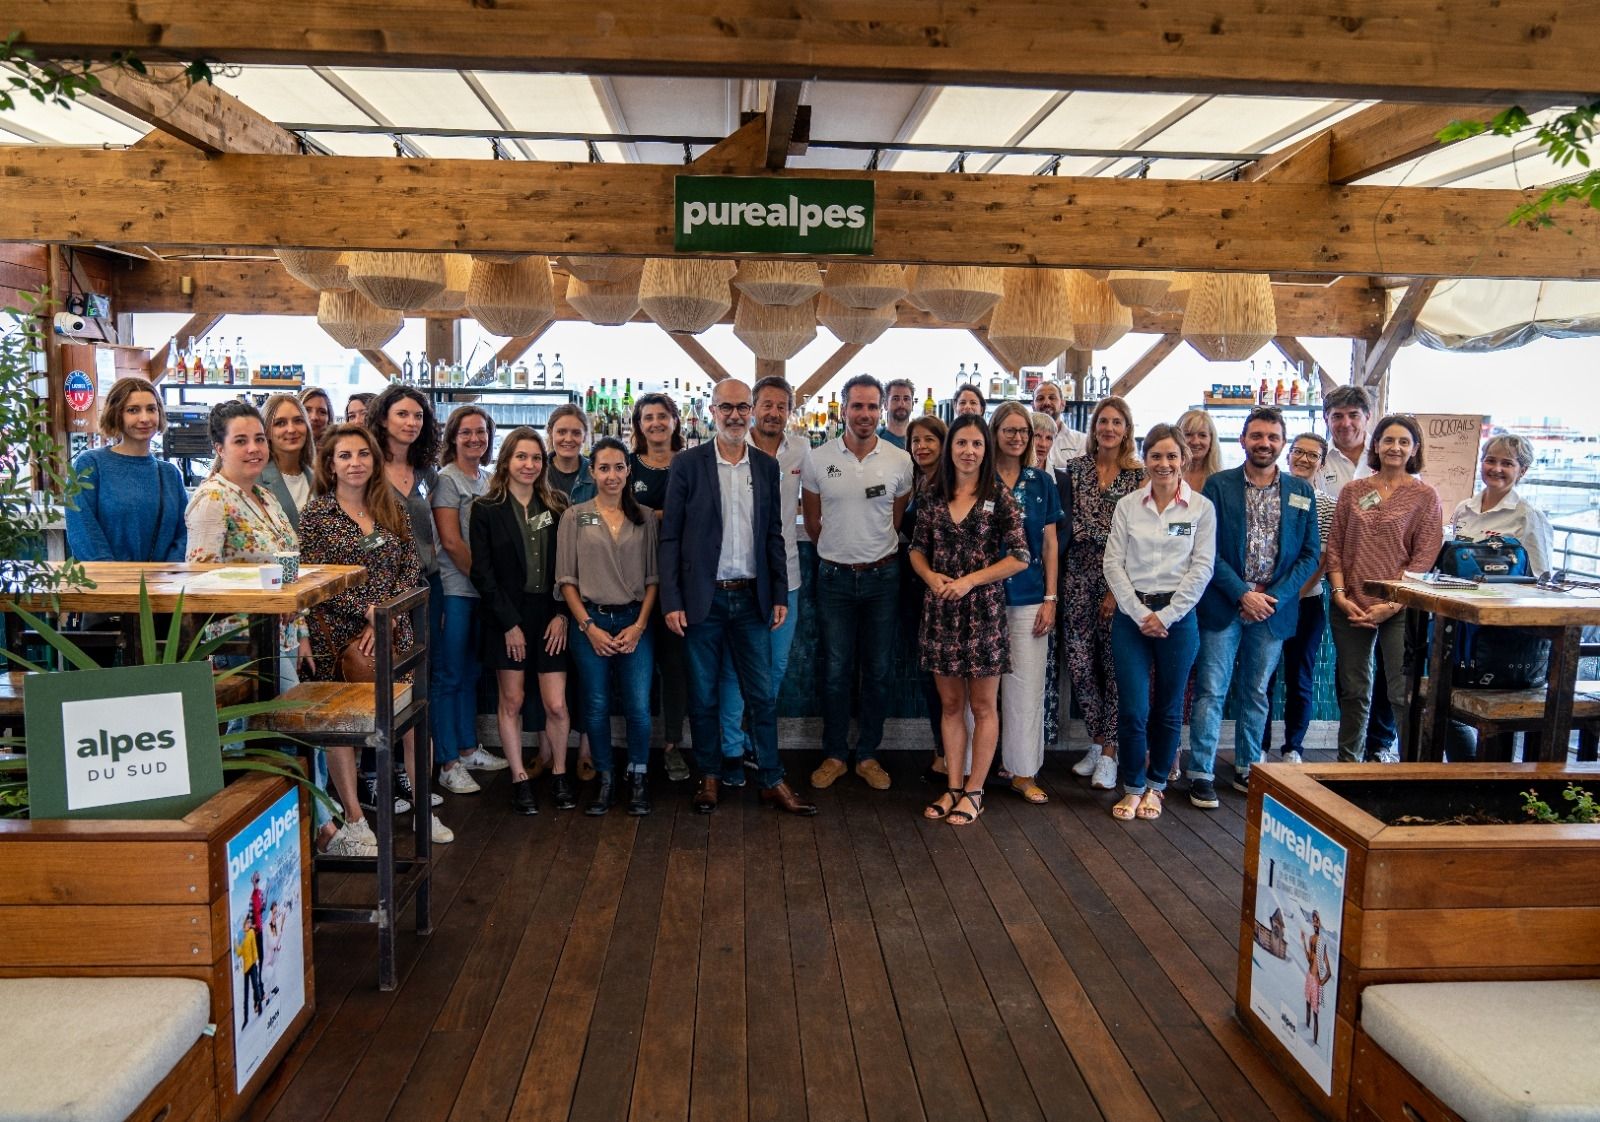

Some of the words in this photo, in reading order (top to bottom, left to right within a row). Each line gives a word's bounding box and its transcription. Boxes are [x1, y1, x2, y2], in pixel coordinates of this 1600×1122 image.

[683, 194, 866, 237] purealpes
[74, 392, 84, 401] IV
[1429, 418, 1475, 437] COCKTAILS
[76, 727, 176, 763] alpes
[88, 766, 115, 782] DU
[127, 761, 168, 777] SUD
[229, 803, 299, 891] purealpes
[1261, 808, 1344, 888] purealpes
